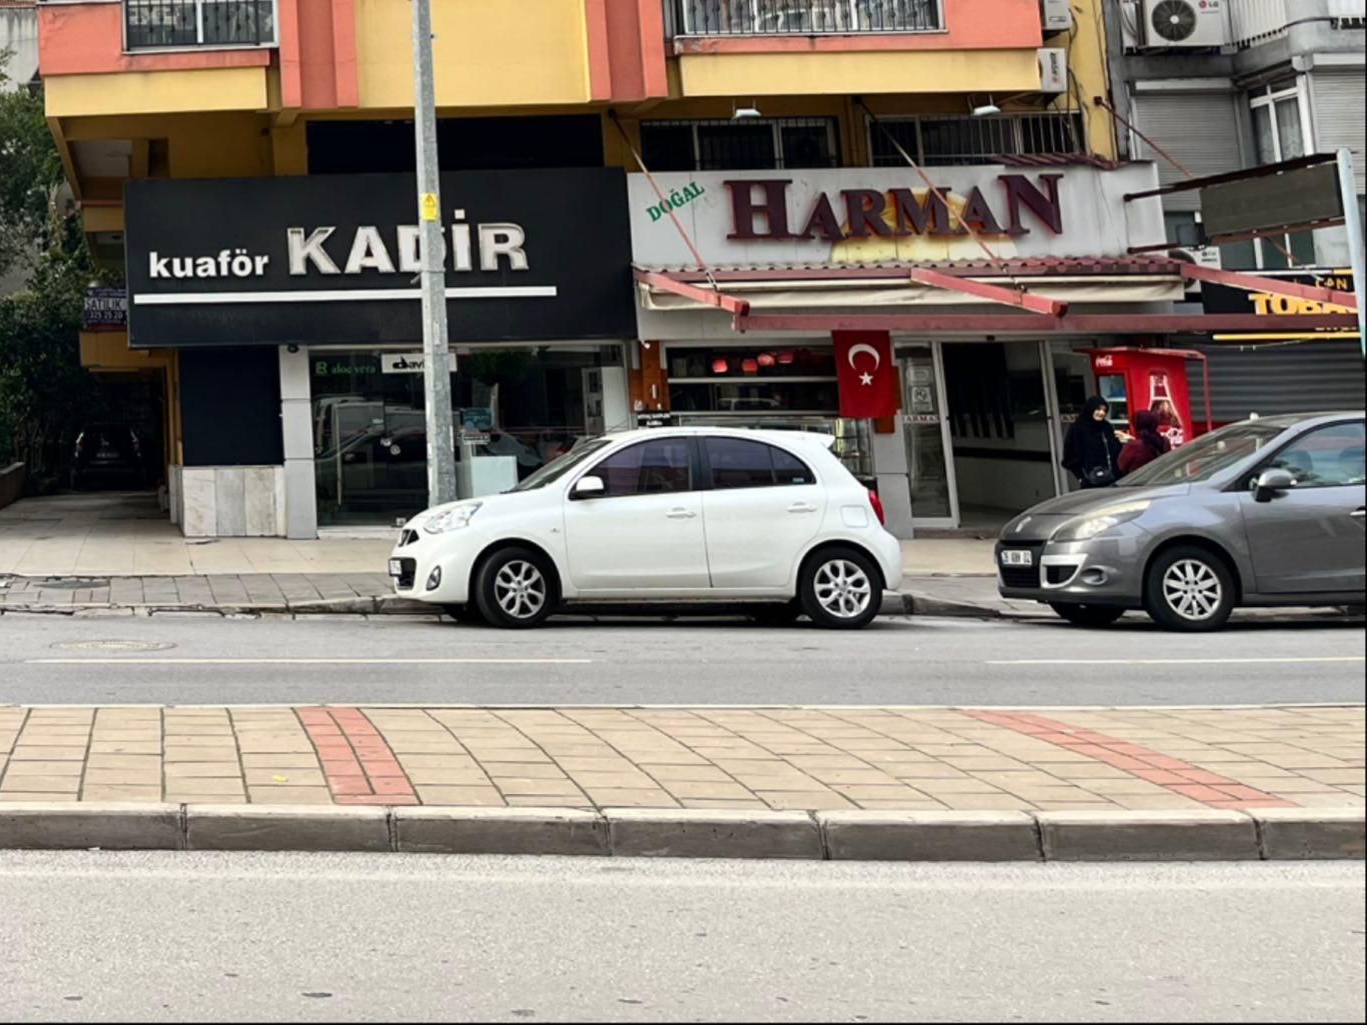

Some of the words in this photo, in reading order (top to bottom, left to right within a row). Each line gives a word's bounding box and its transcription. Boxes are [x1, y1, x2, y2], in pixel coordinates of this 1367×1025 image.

[646, 180, 706, 222] DOĞAL
[723, 174, 1064, 240] HARMAN
[149, 249, 269, 277] kuaför
